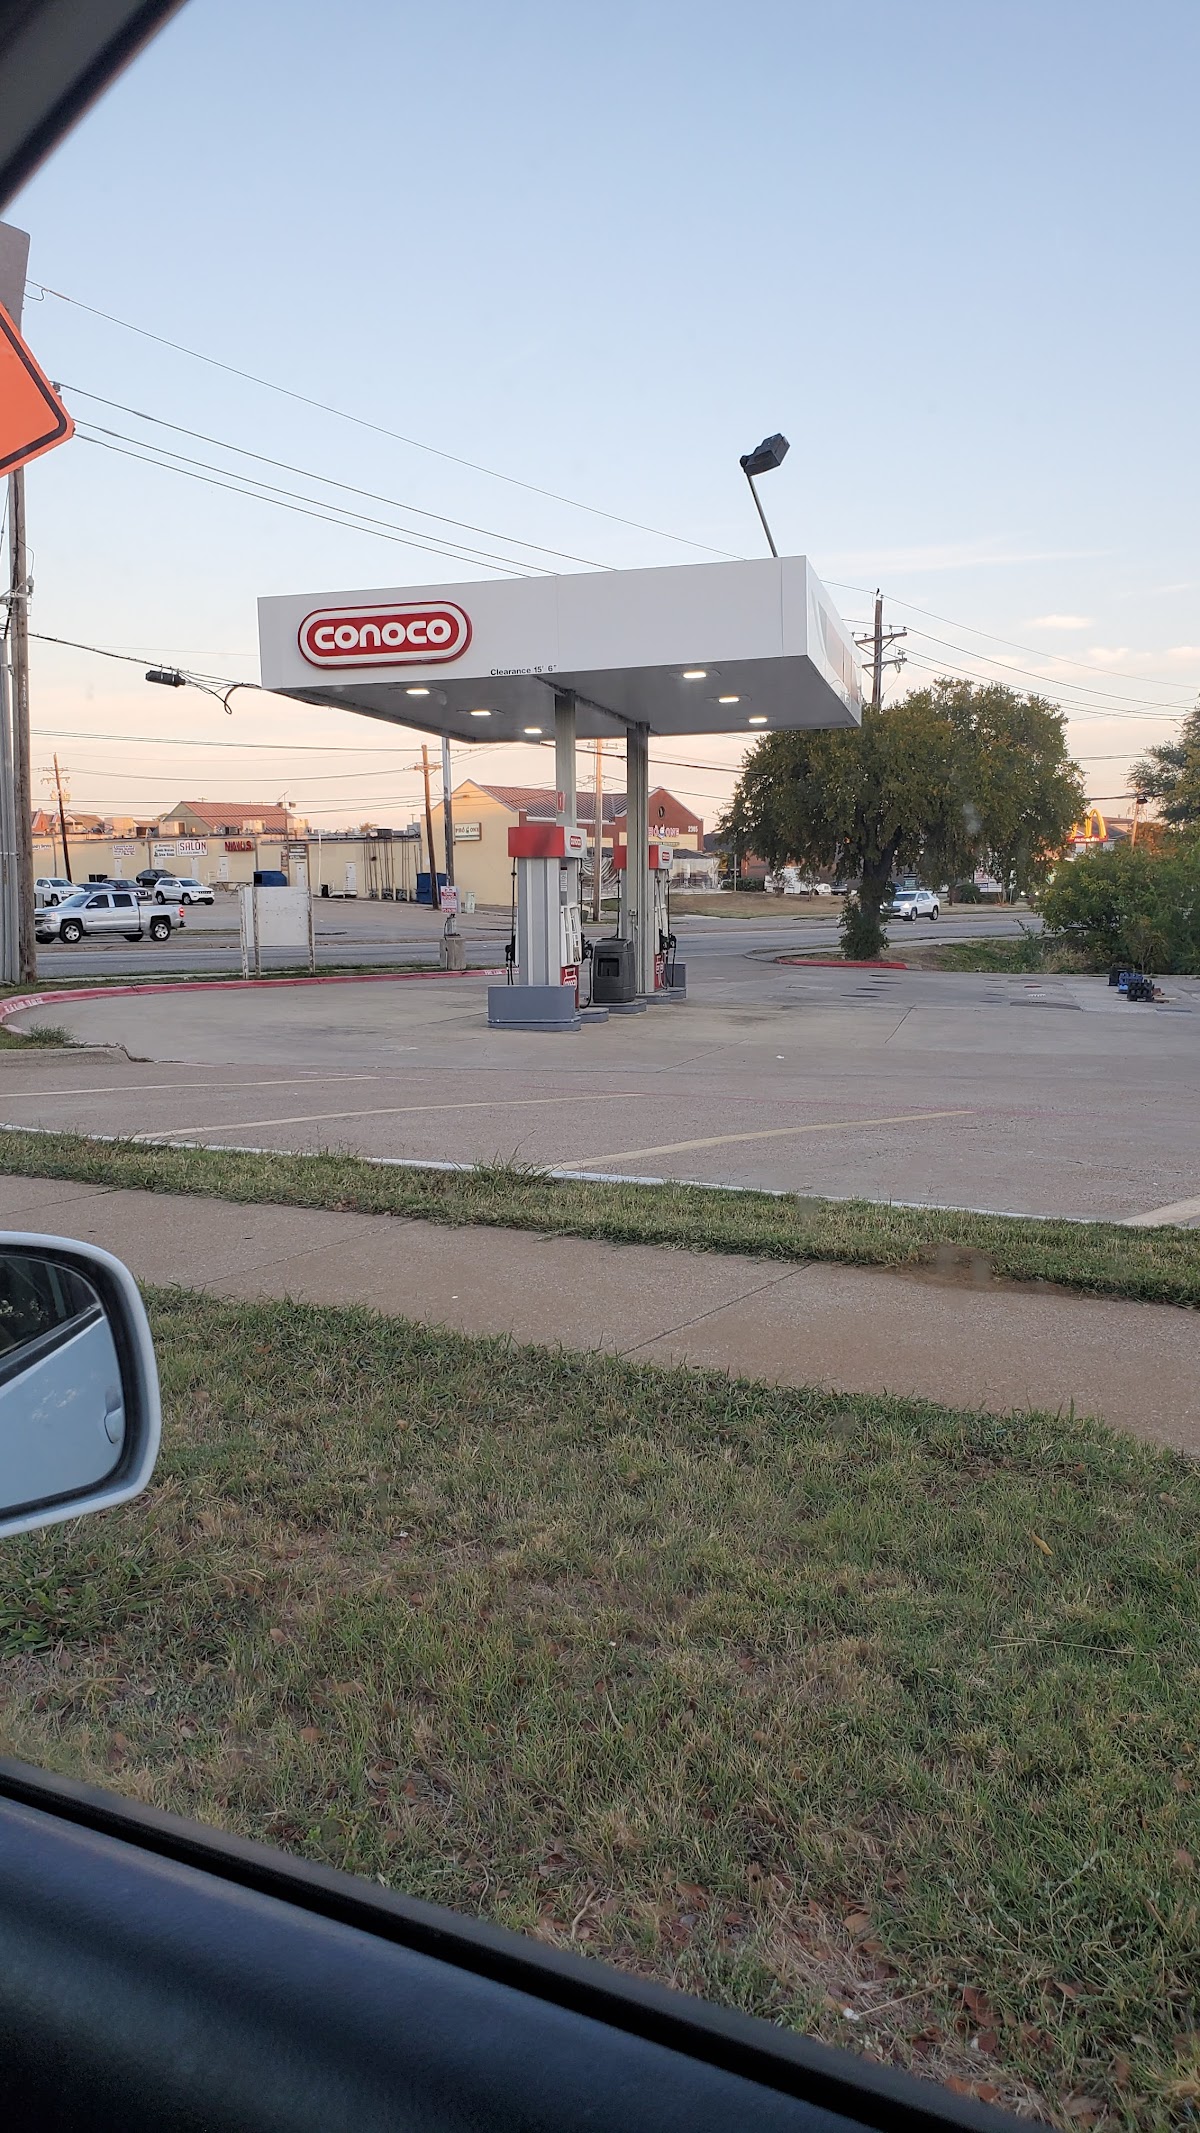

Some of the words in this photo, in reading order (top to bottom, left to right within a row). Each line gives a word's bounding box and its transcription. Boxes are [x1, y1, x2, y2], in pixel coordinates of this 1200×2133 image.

[490, 667, 531, 676] Clearance
[533, 665, 544, 673] 15'
[180, 841, 207, 850] SALON
[225, 840, 252, 852] NAILS
